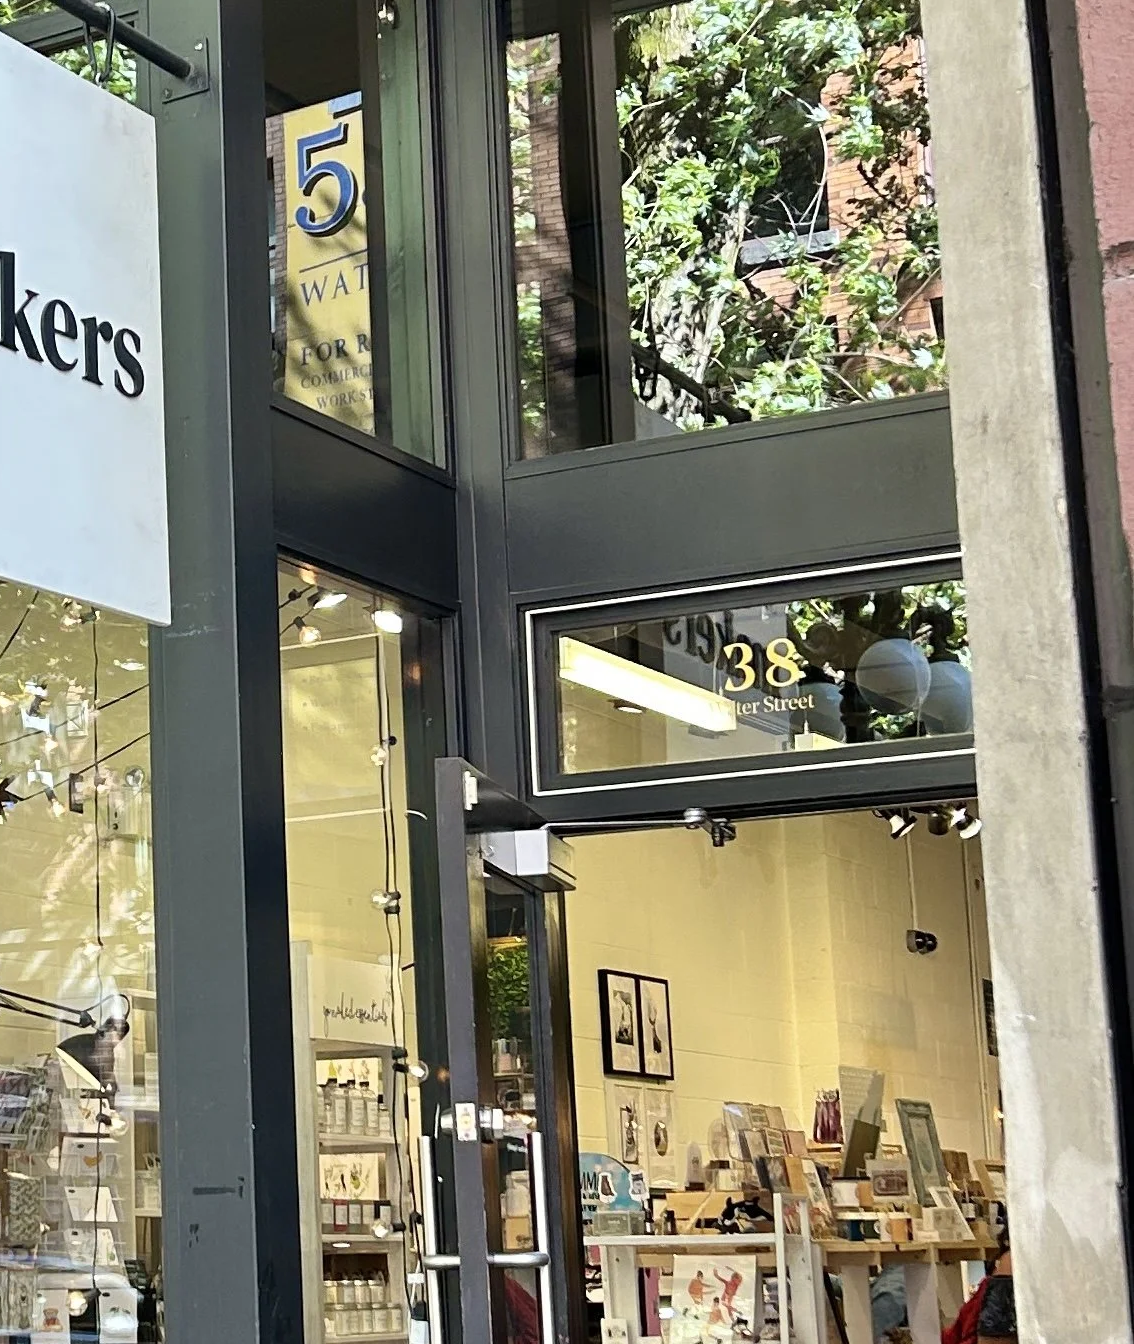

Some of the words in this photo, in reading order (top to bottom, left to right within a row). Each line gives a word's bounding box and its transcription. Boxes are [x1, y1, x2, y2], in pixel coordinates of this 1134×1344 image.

[298, 262, 370, 307] WAT
[299, 337, 349, 367] FOR
[723, 637, 804, 693] 38
[763, 693, 815, 714] Street
